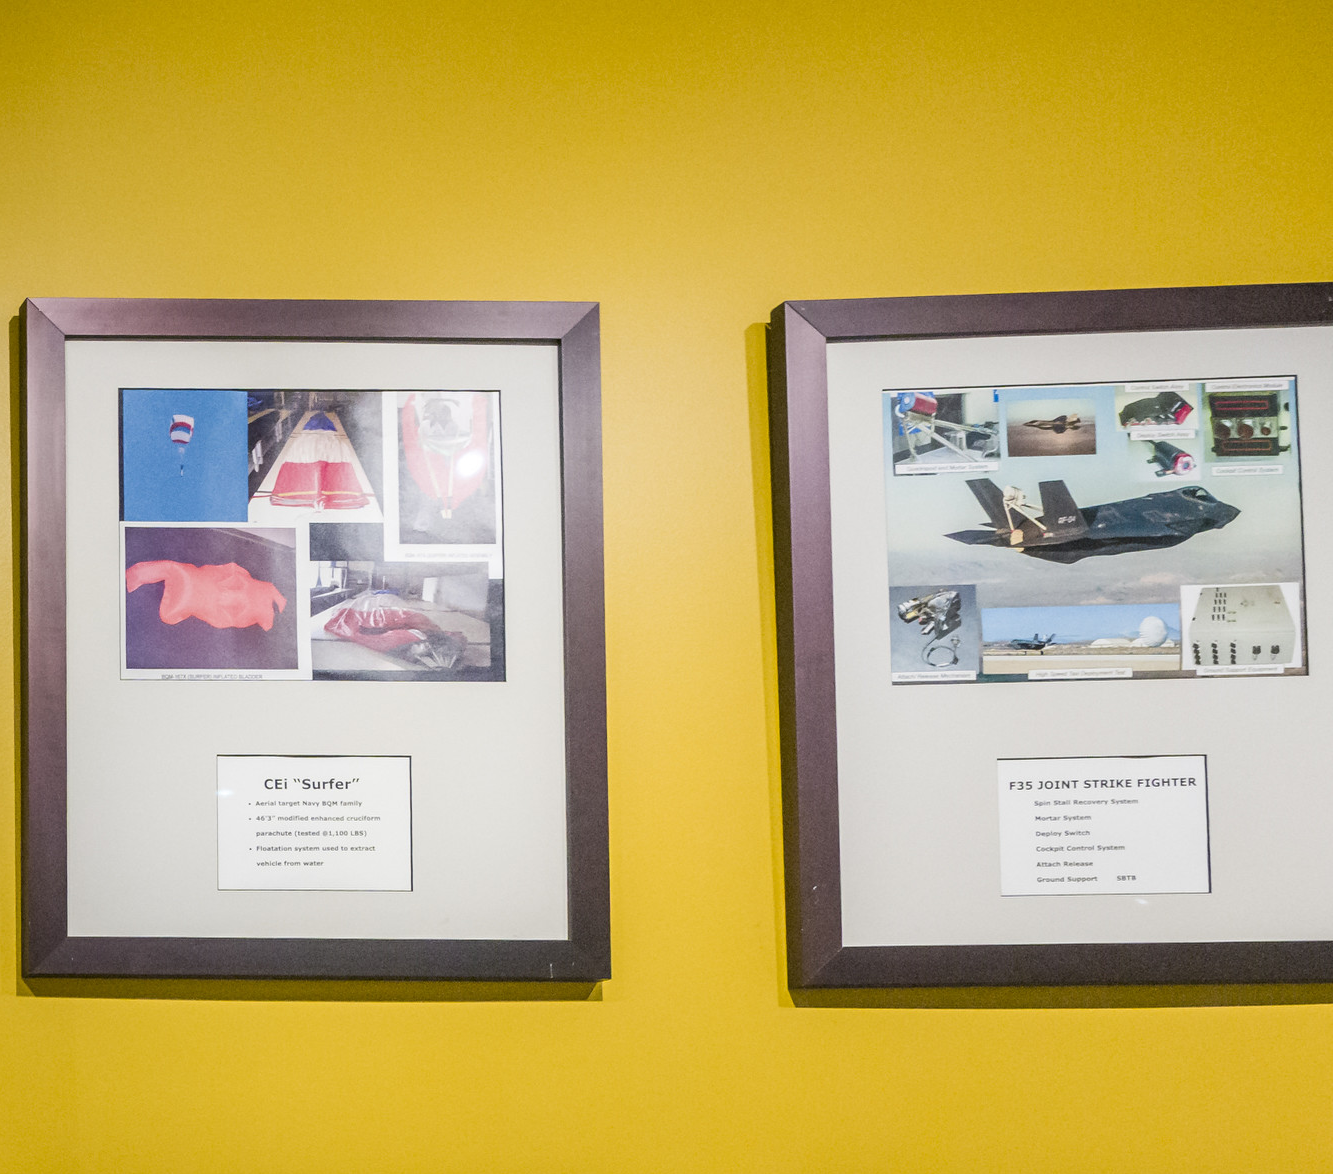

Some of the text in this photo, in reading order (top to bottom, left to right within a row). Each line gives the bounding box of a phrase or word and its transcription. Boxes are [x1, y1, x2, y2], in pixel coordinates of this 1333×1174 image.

[264, 778, 359, 790] CEi “Surfer”
[1009, 777, 1197, 790] F35 JOINT STRIKE FIGHTER
